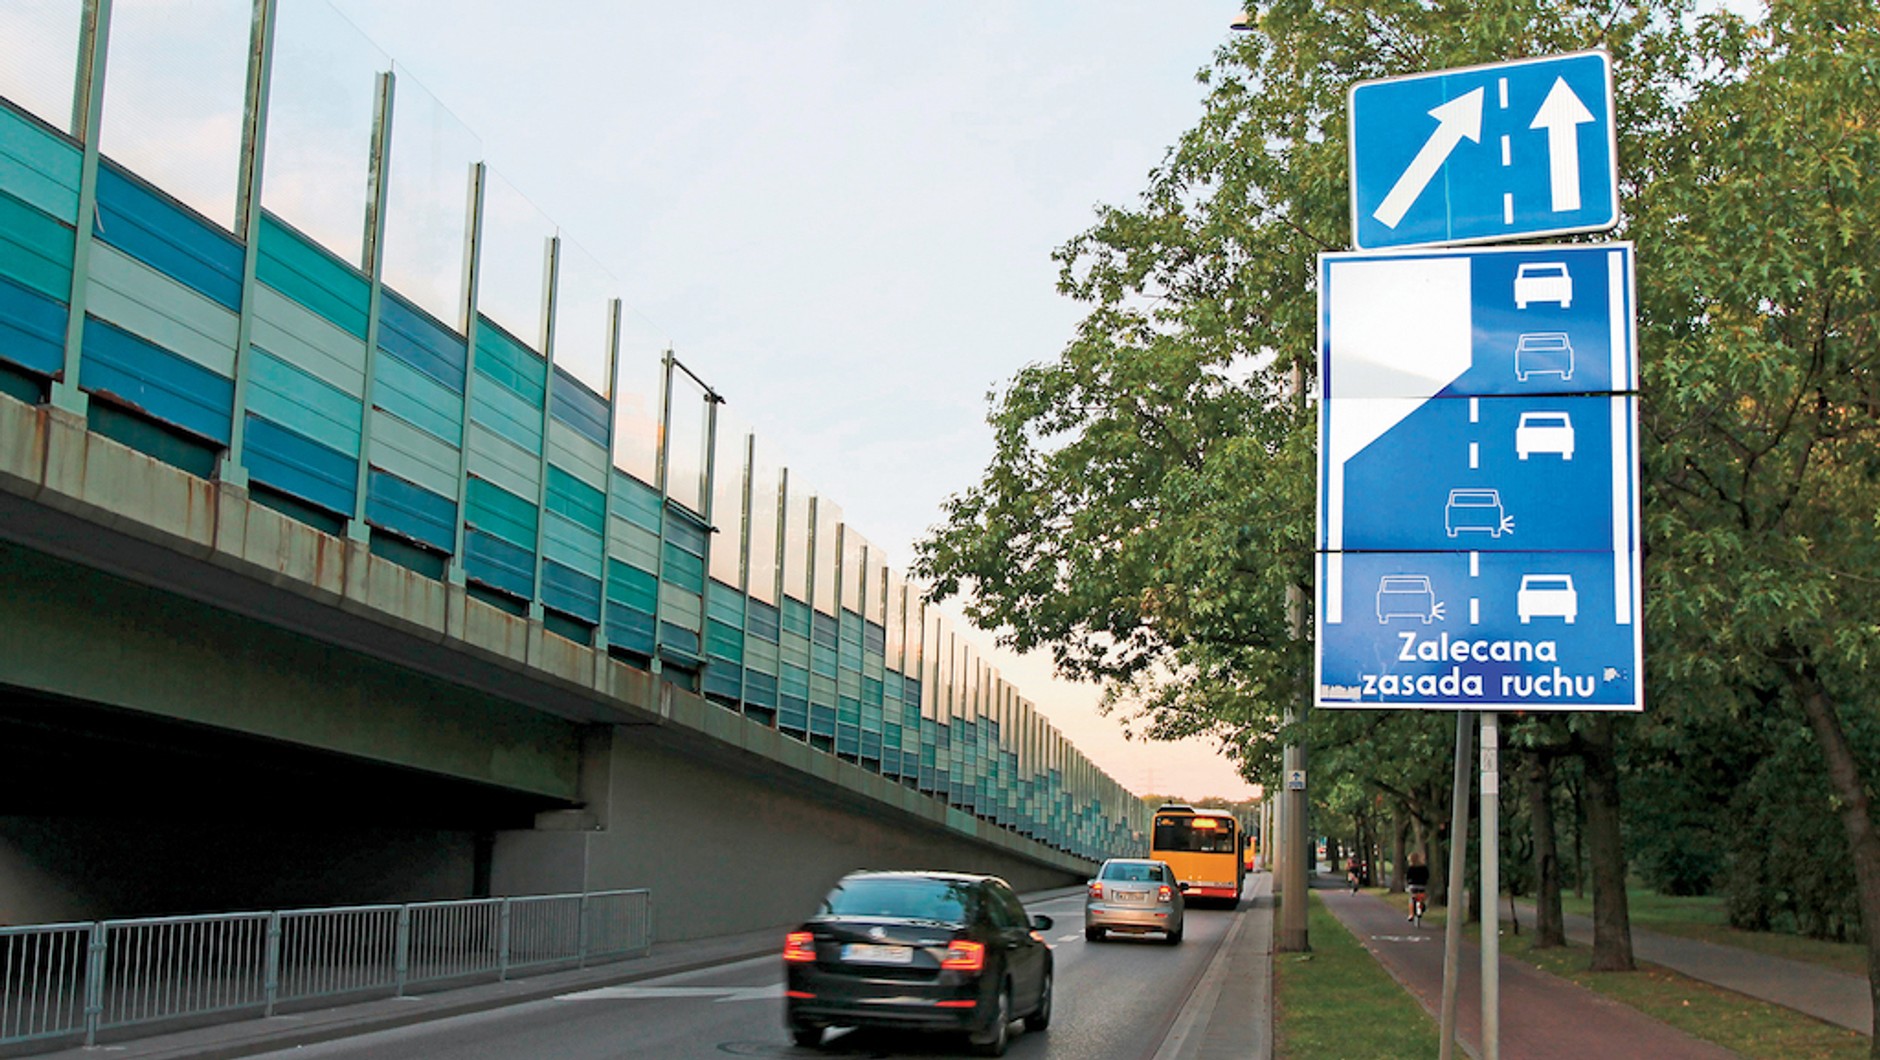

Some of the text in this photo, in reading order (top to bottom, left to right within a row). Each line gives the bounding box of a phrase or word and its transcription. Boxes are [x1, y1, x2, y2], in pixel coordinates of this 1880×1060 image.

[1397, 631, 1557, 662] Zalecana
[1362, 666, 1595, 697] zasada ruchu
